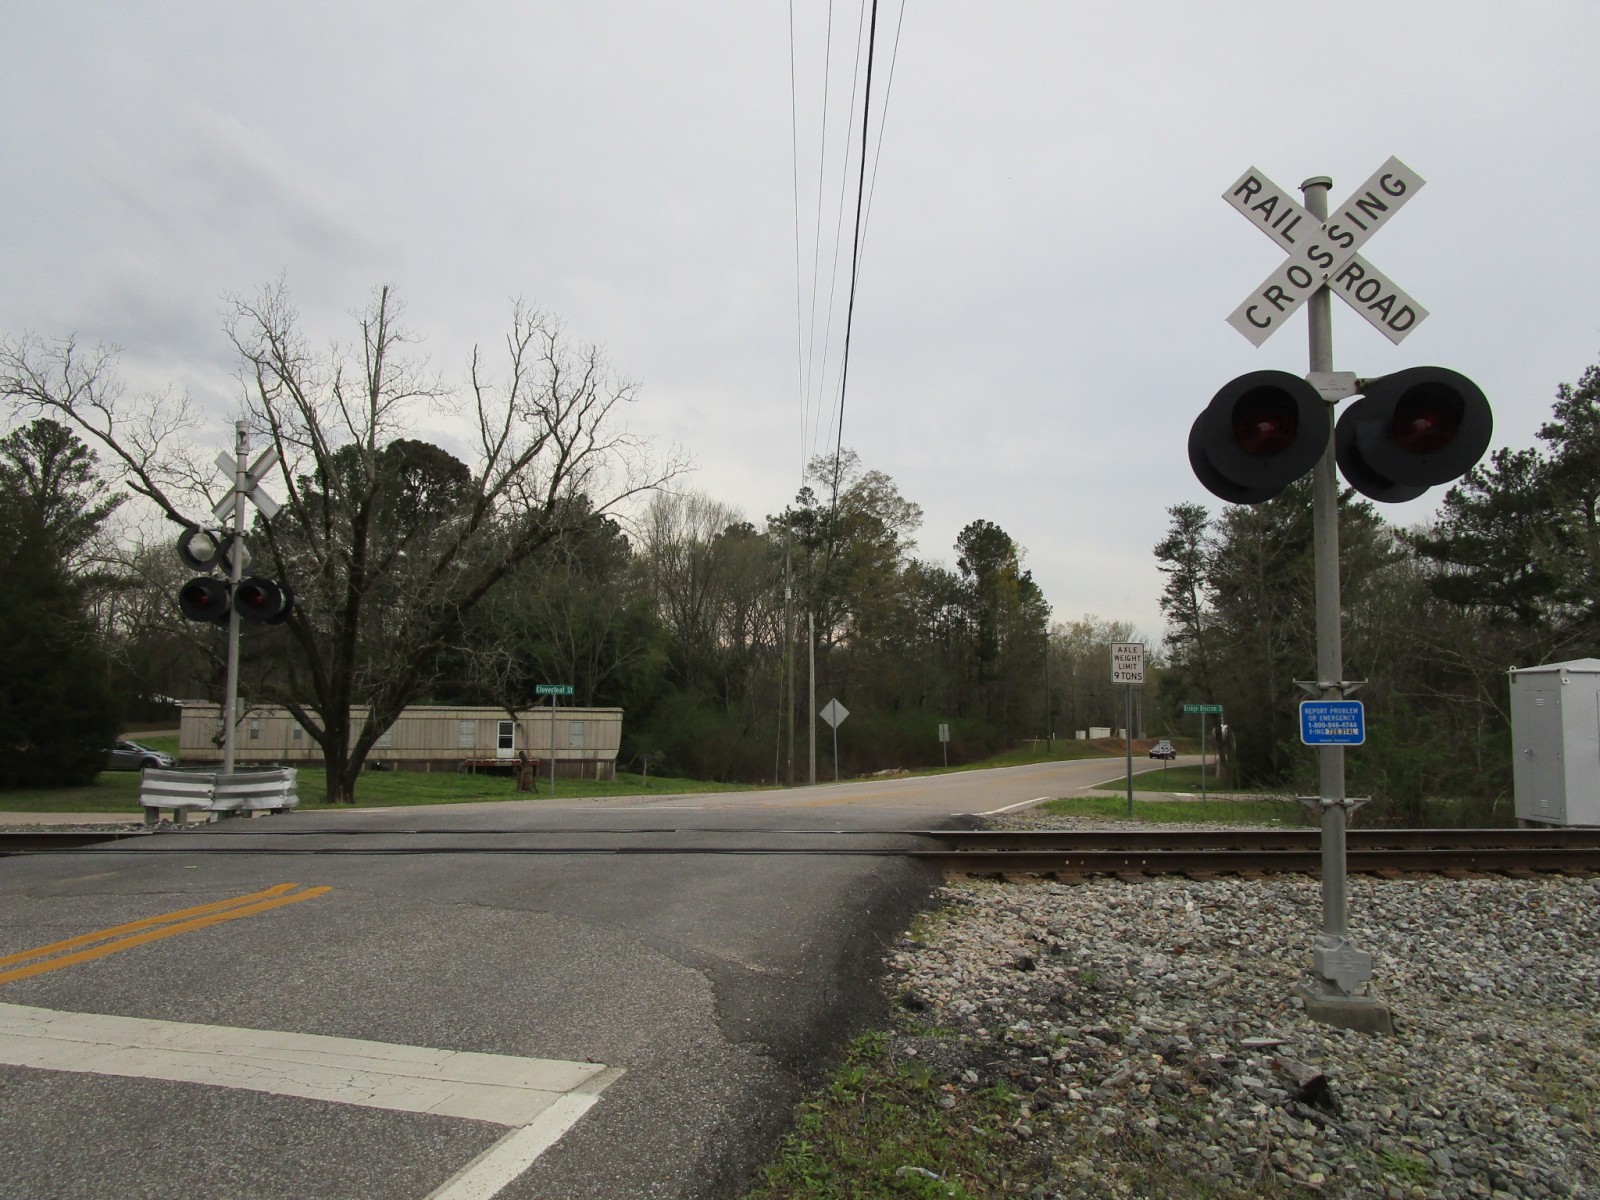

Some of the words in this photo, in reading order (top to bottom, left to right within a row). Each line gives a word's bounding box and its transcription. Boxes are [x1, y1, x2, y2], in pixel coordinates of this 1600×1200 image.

[1233, 175, 1302, 244] RAIL
[1246, 173, 1406, 328] CROSSING
[1335, 261, 1416, 331] ROAD
[536, 685, 565, 693] Cloverleaf
[567, 686, 573, 694] St
[1114, 671, 1119, 679] 9
[1121, 672, 1142, 680] TONS
